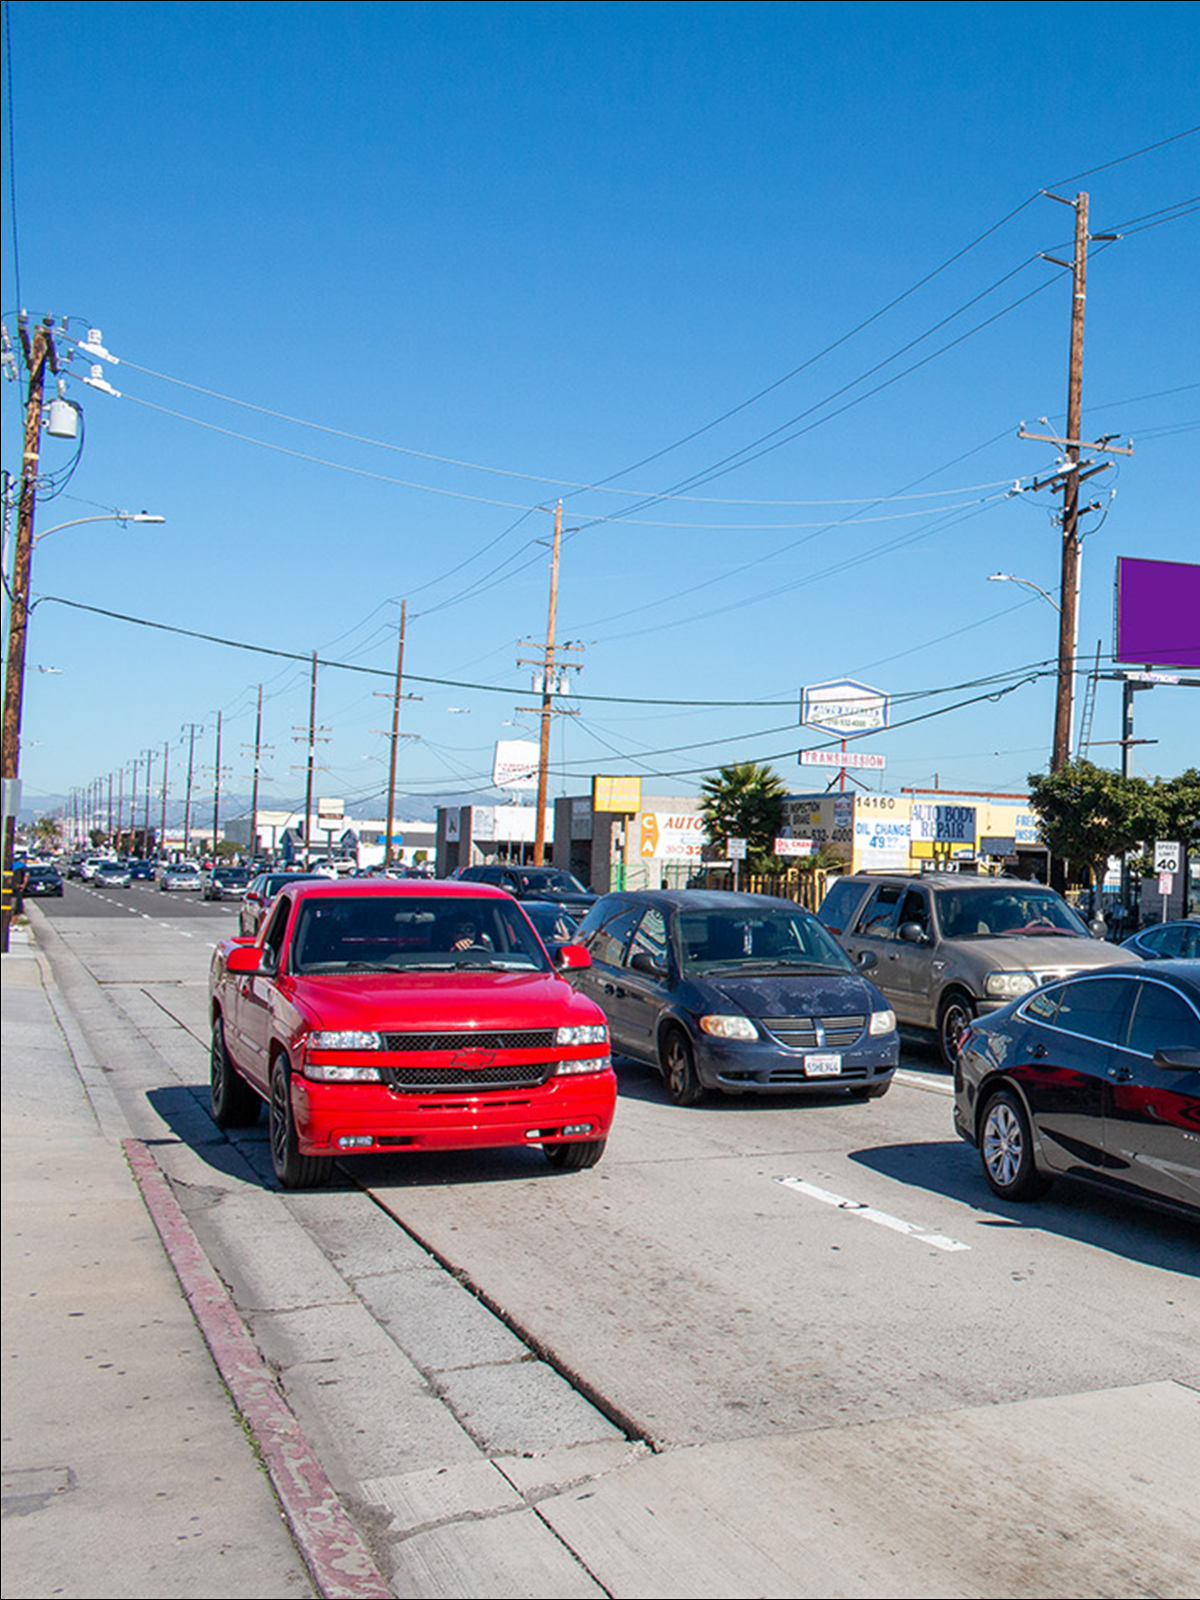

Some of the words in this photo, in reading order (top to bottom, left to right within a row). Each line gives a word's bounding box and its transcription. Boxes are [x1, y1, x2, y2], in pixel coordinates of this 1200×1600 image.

[805, 751, 884, 767] TRANSMISSION
[856, 797, 895, 809] 14160
[911, 804, 942, 821] AUTO
[945, 806, 975, 823] BODY
[663, 816, 705, 830] AUTO
[855, 822, 870, 835] OIL
[874, 823, 911, 837] CHANGE
[921, 821, 965, 838] REPAIR
[1156, 859, 1177, 871] 40
